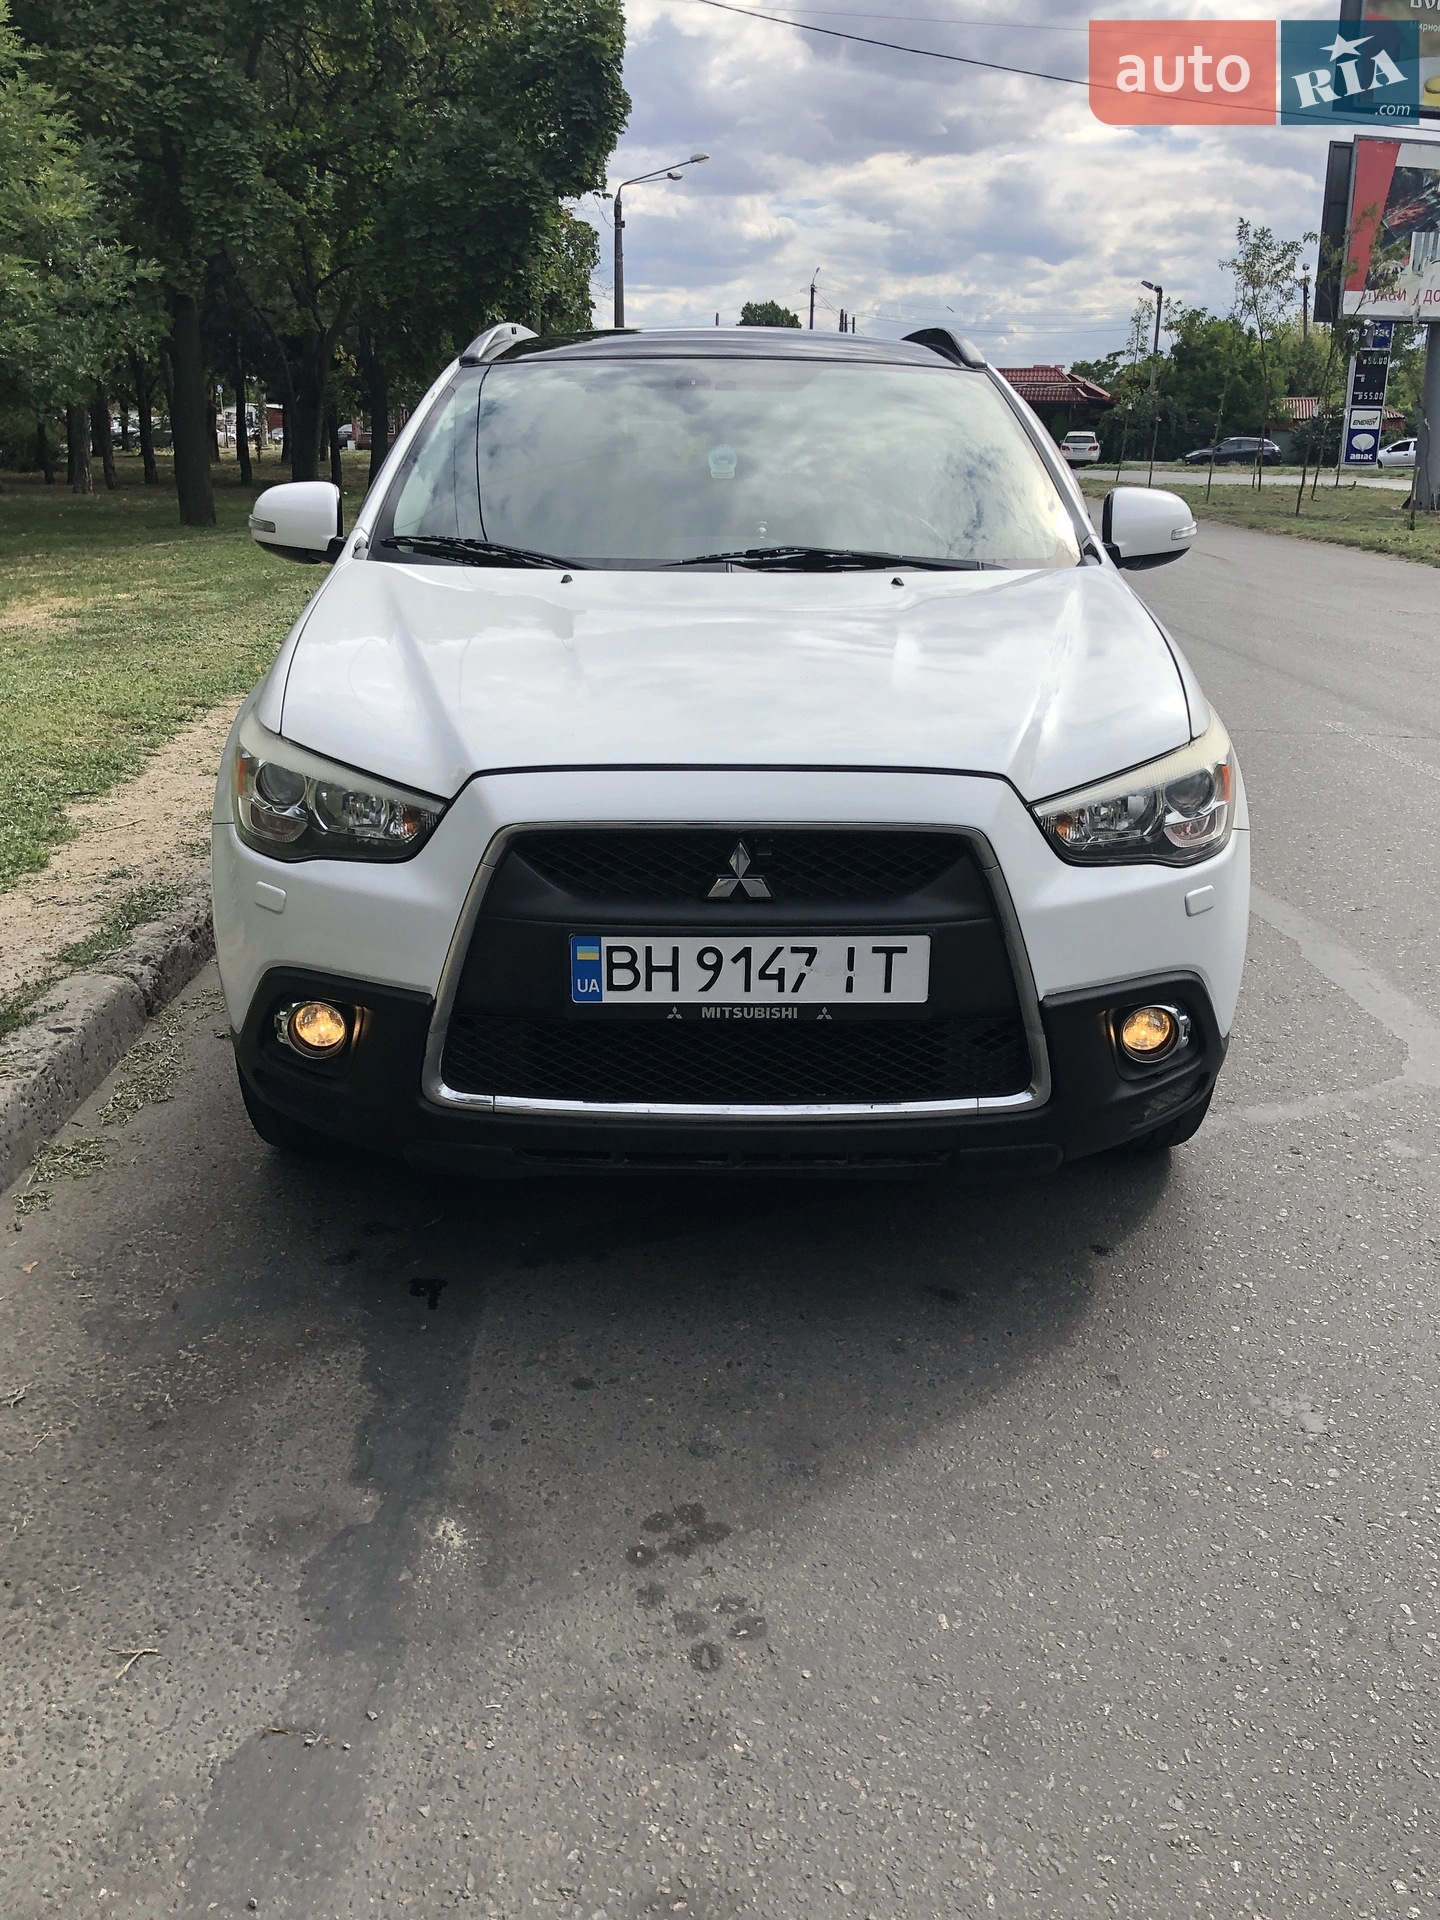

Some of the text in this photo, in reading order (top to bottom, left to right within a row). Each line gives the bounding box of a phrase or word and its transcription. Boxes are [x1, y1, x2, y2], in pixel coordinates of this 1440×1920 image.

[606, 945, 680, 992] BH
[696, 945, 818, 993] 9147
[577, 978, 600, 993] UA
[701, 1006, 798, 1019] MITSUBISHI
